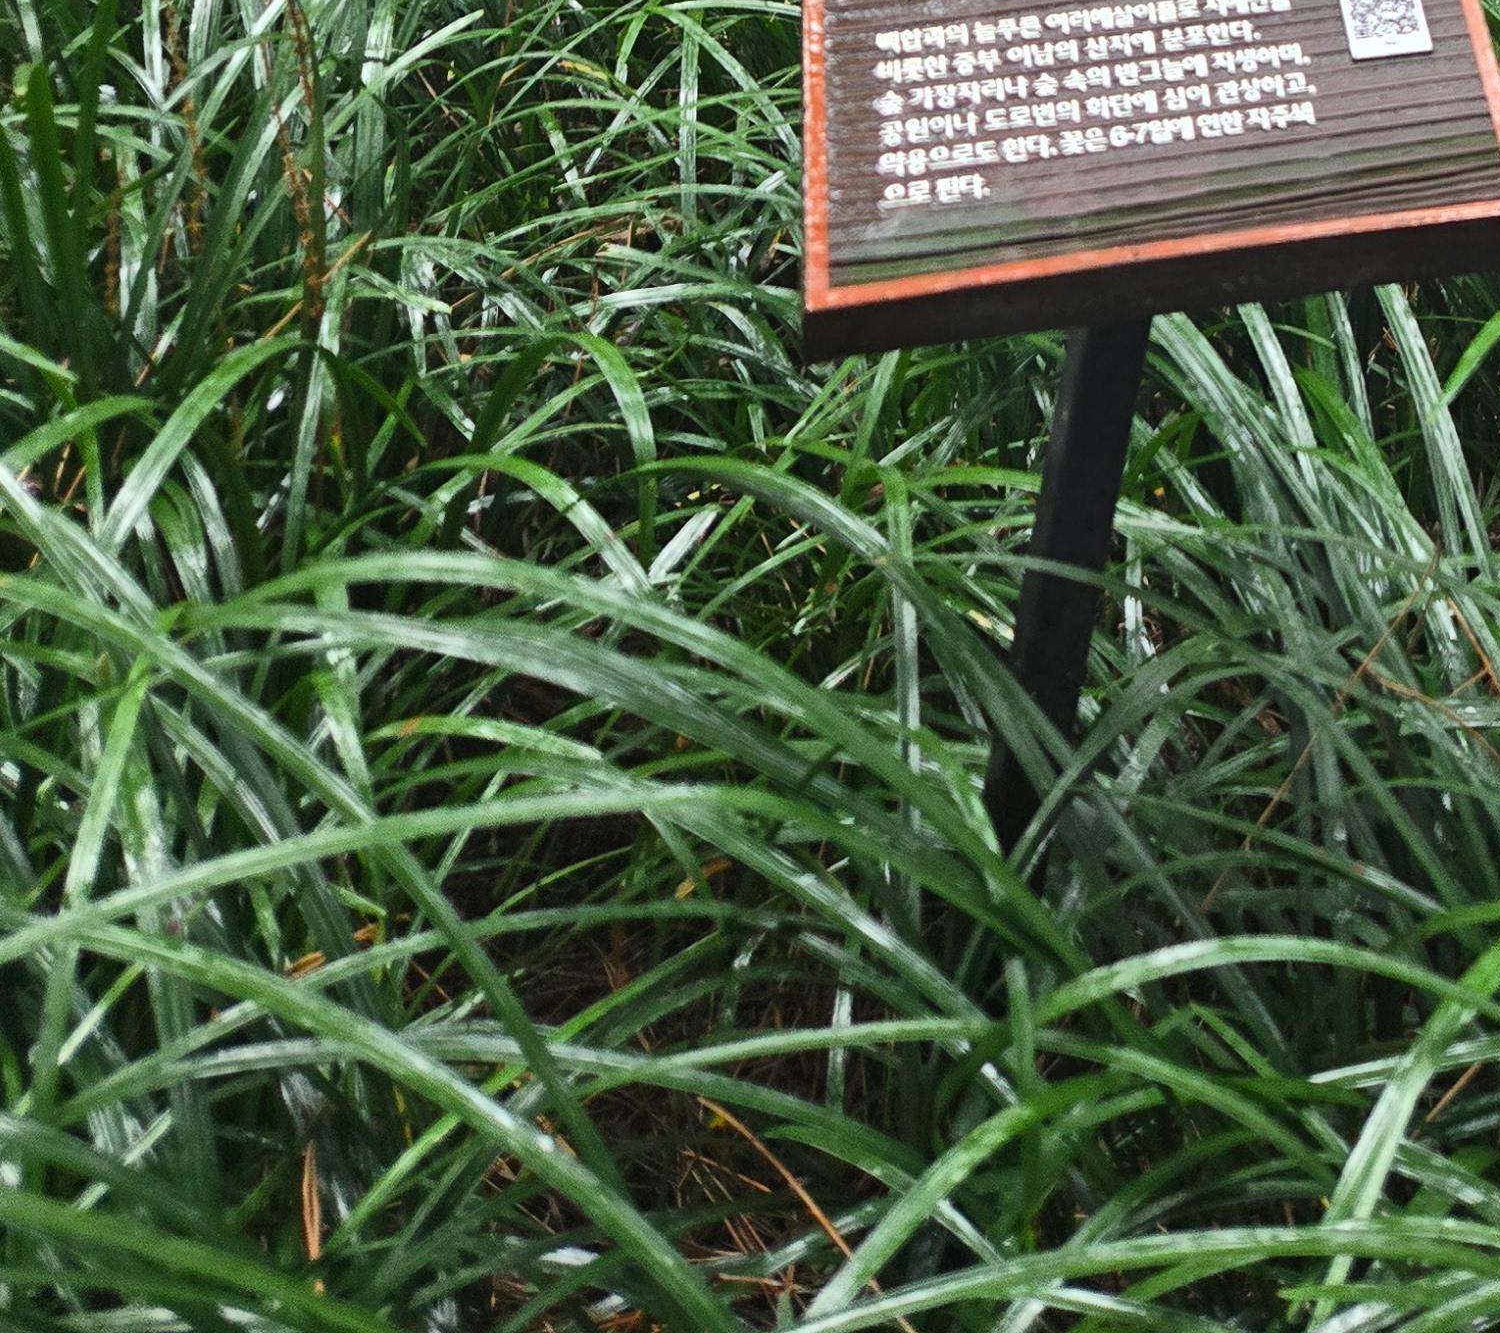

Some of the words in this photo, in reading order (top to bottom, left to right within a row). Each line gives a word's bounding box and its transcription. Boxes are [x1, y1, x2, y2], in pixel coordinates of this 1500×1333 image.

[874, 54, 949, 83] 비롯한
[952, 49, 1001, 76] 중부
[1006, 39, 1079, 68] 이남의
[1083, 30, 1156, 60] 산지에
[1161, 19, 1262, 51] 분포한다.
[875, 23, 969, 53] 백합과의
[973, 15, 1042, 44] 늘푸른
[873, 90, 905, 116] 숲
[907, 75, 1028, 110] 가장자리나
[1032, 72, 1059, 97] 숲
[1063, 65, 1111, 92] 속의
[1114, 53, 1209, 87] 반그늘에
[879, 111, 978, 147] 공원이나
[984, 99, 1080, 131] 도로변의
[1085, 90, 1158, 119] 화단에
[1163, 84, 1211, 111] 심어
[877, 140, 1000, 177] 약용으로도
[1002, 134, 1058, 163] 한다.
[1060, 127, 1108, 155] 꽃은
[1197, 110, 1244, 138] 연한
[1246, 101, 1316, 130] 자주색
[879, 180, 932, 210] 으로
